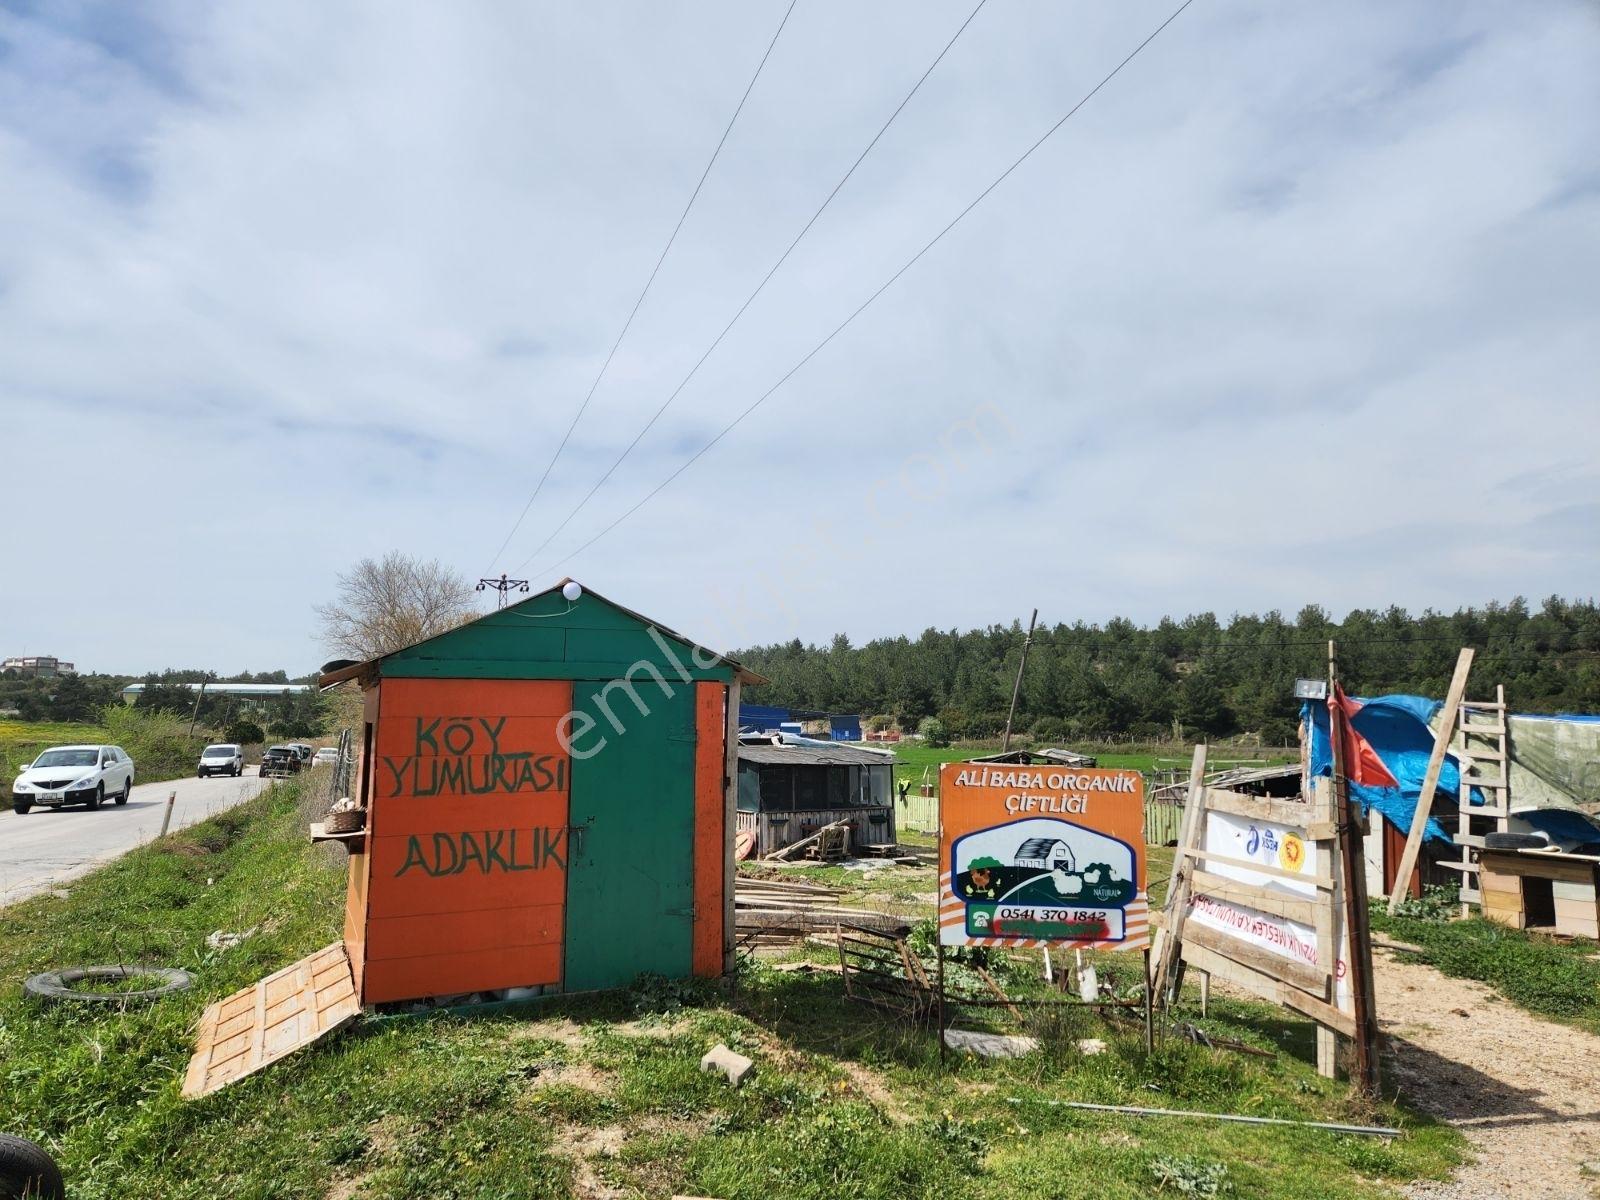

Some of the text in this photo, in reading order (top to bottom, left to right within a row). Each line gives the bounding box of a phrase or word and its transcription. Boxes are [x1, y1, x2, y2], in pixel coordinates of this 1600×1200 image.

[383, 752, 566, 798] YUMURTASI
[990, 771, 1043, 789] BABA
[1047, 772, 1137, 793] ORGANİK
[1005, 792, 1088, 815] ÇİFTLİĞİ
[394, 827, 567, 878] ADAKLIK
[1000, 908, 1107, 922] 0541 370 1842
